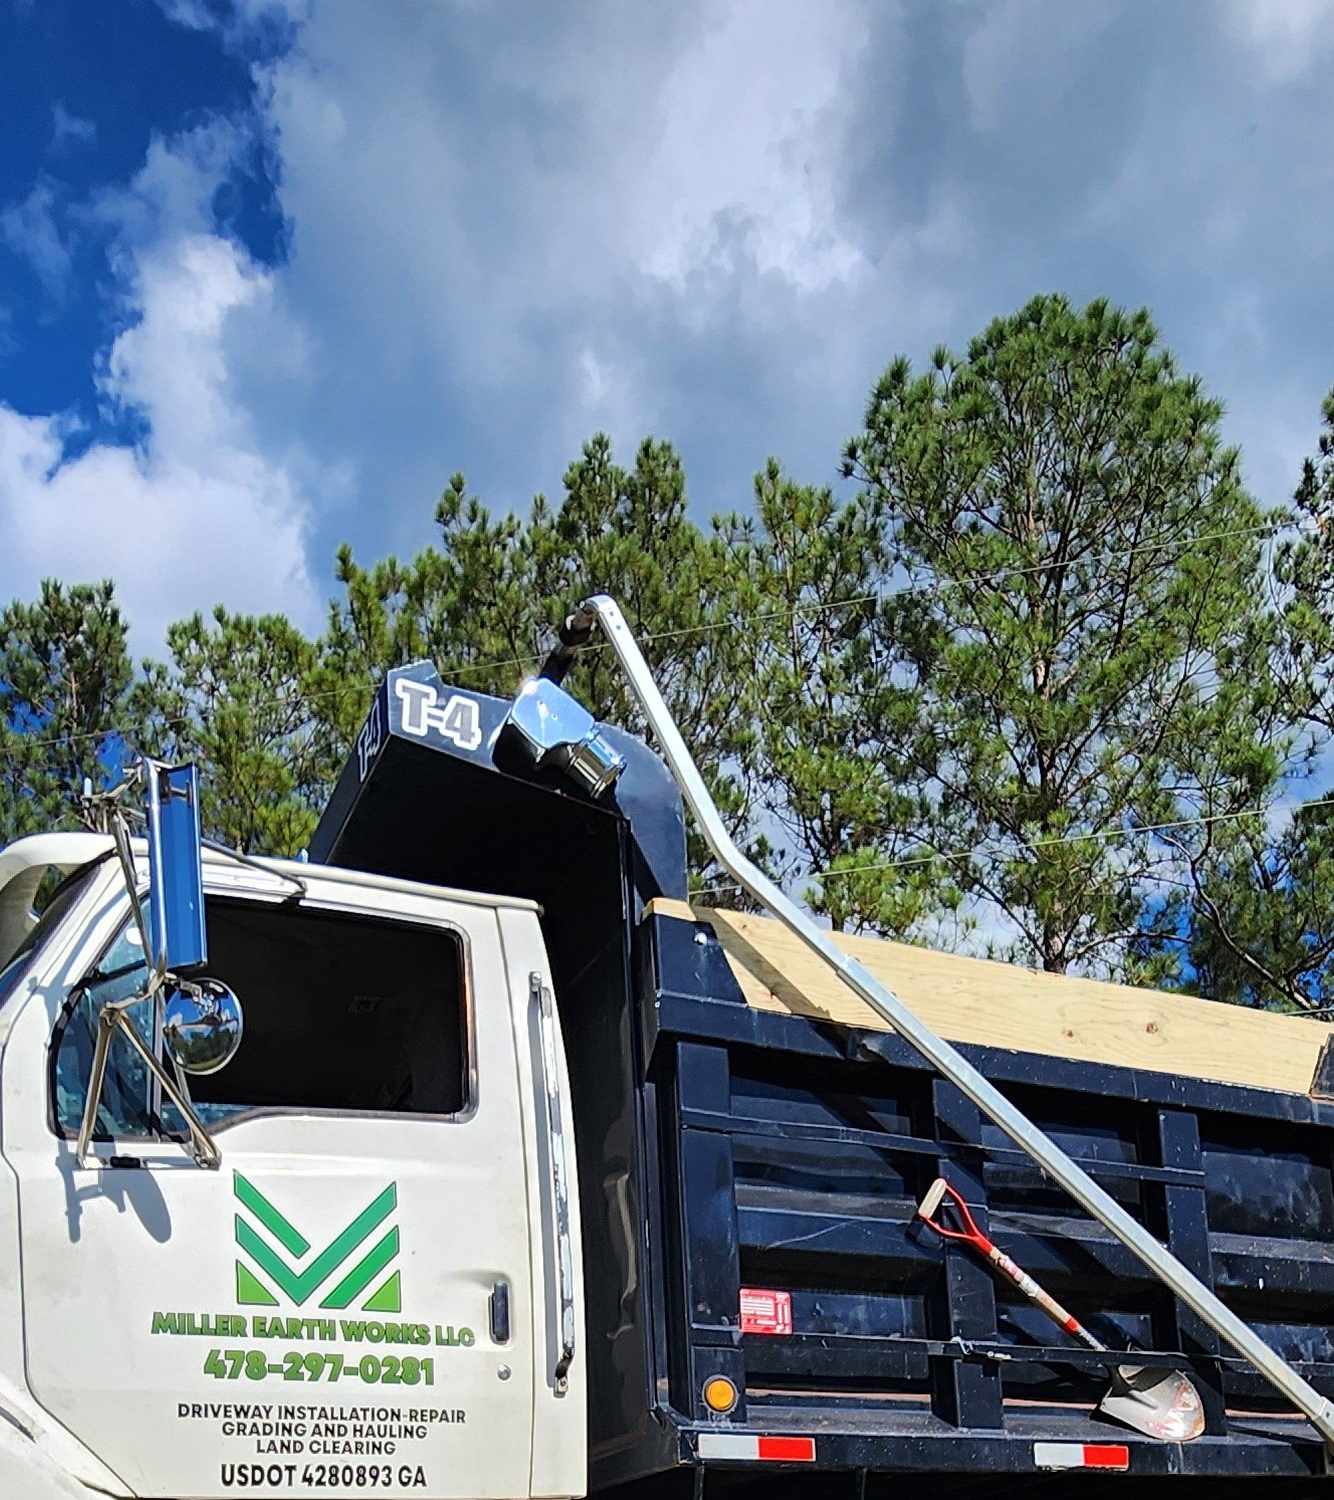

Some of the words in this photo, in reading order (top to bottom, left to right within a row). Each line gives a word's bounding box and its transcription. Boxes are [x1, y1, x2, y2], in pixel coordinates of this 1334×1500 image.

[395, 678, 482, 751] T-4
[151, 1311, 248, 1337] MILLER
[252, 1316, 336, 1341] EARTH
[339, 1319, 431, 1346] WORKS
[435, 1325, 475, 1347] LLC
[203, 1349, 434, 1386] 478-297-0281
[178, 1403, 273, 1419] DRIVEWAY
[278, 1405, 466, 1423] INSTALLATION-REPAIR
[222, 1422, 307, 1436] GRADING
[311, 1424, 348, 1437] AND
[353, 1425, 427, 1439] HAULING
[256, 1440, 304, 1454] LAND
[309, 1441, 396, 1455] CLEARING
[221, 1464, 297, 1487] USDOT
[301, 1464, 392, 1487] 4280893
[398, 1465, 427, 1487] GA
